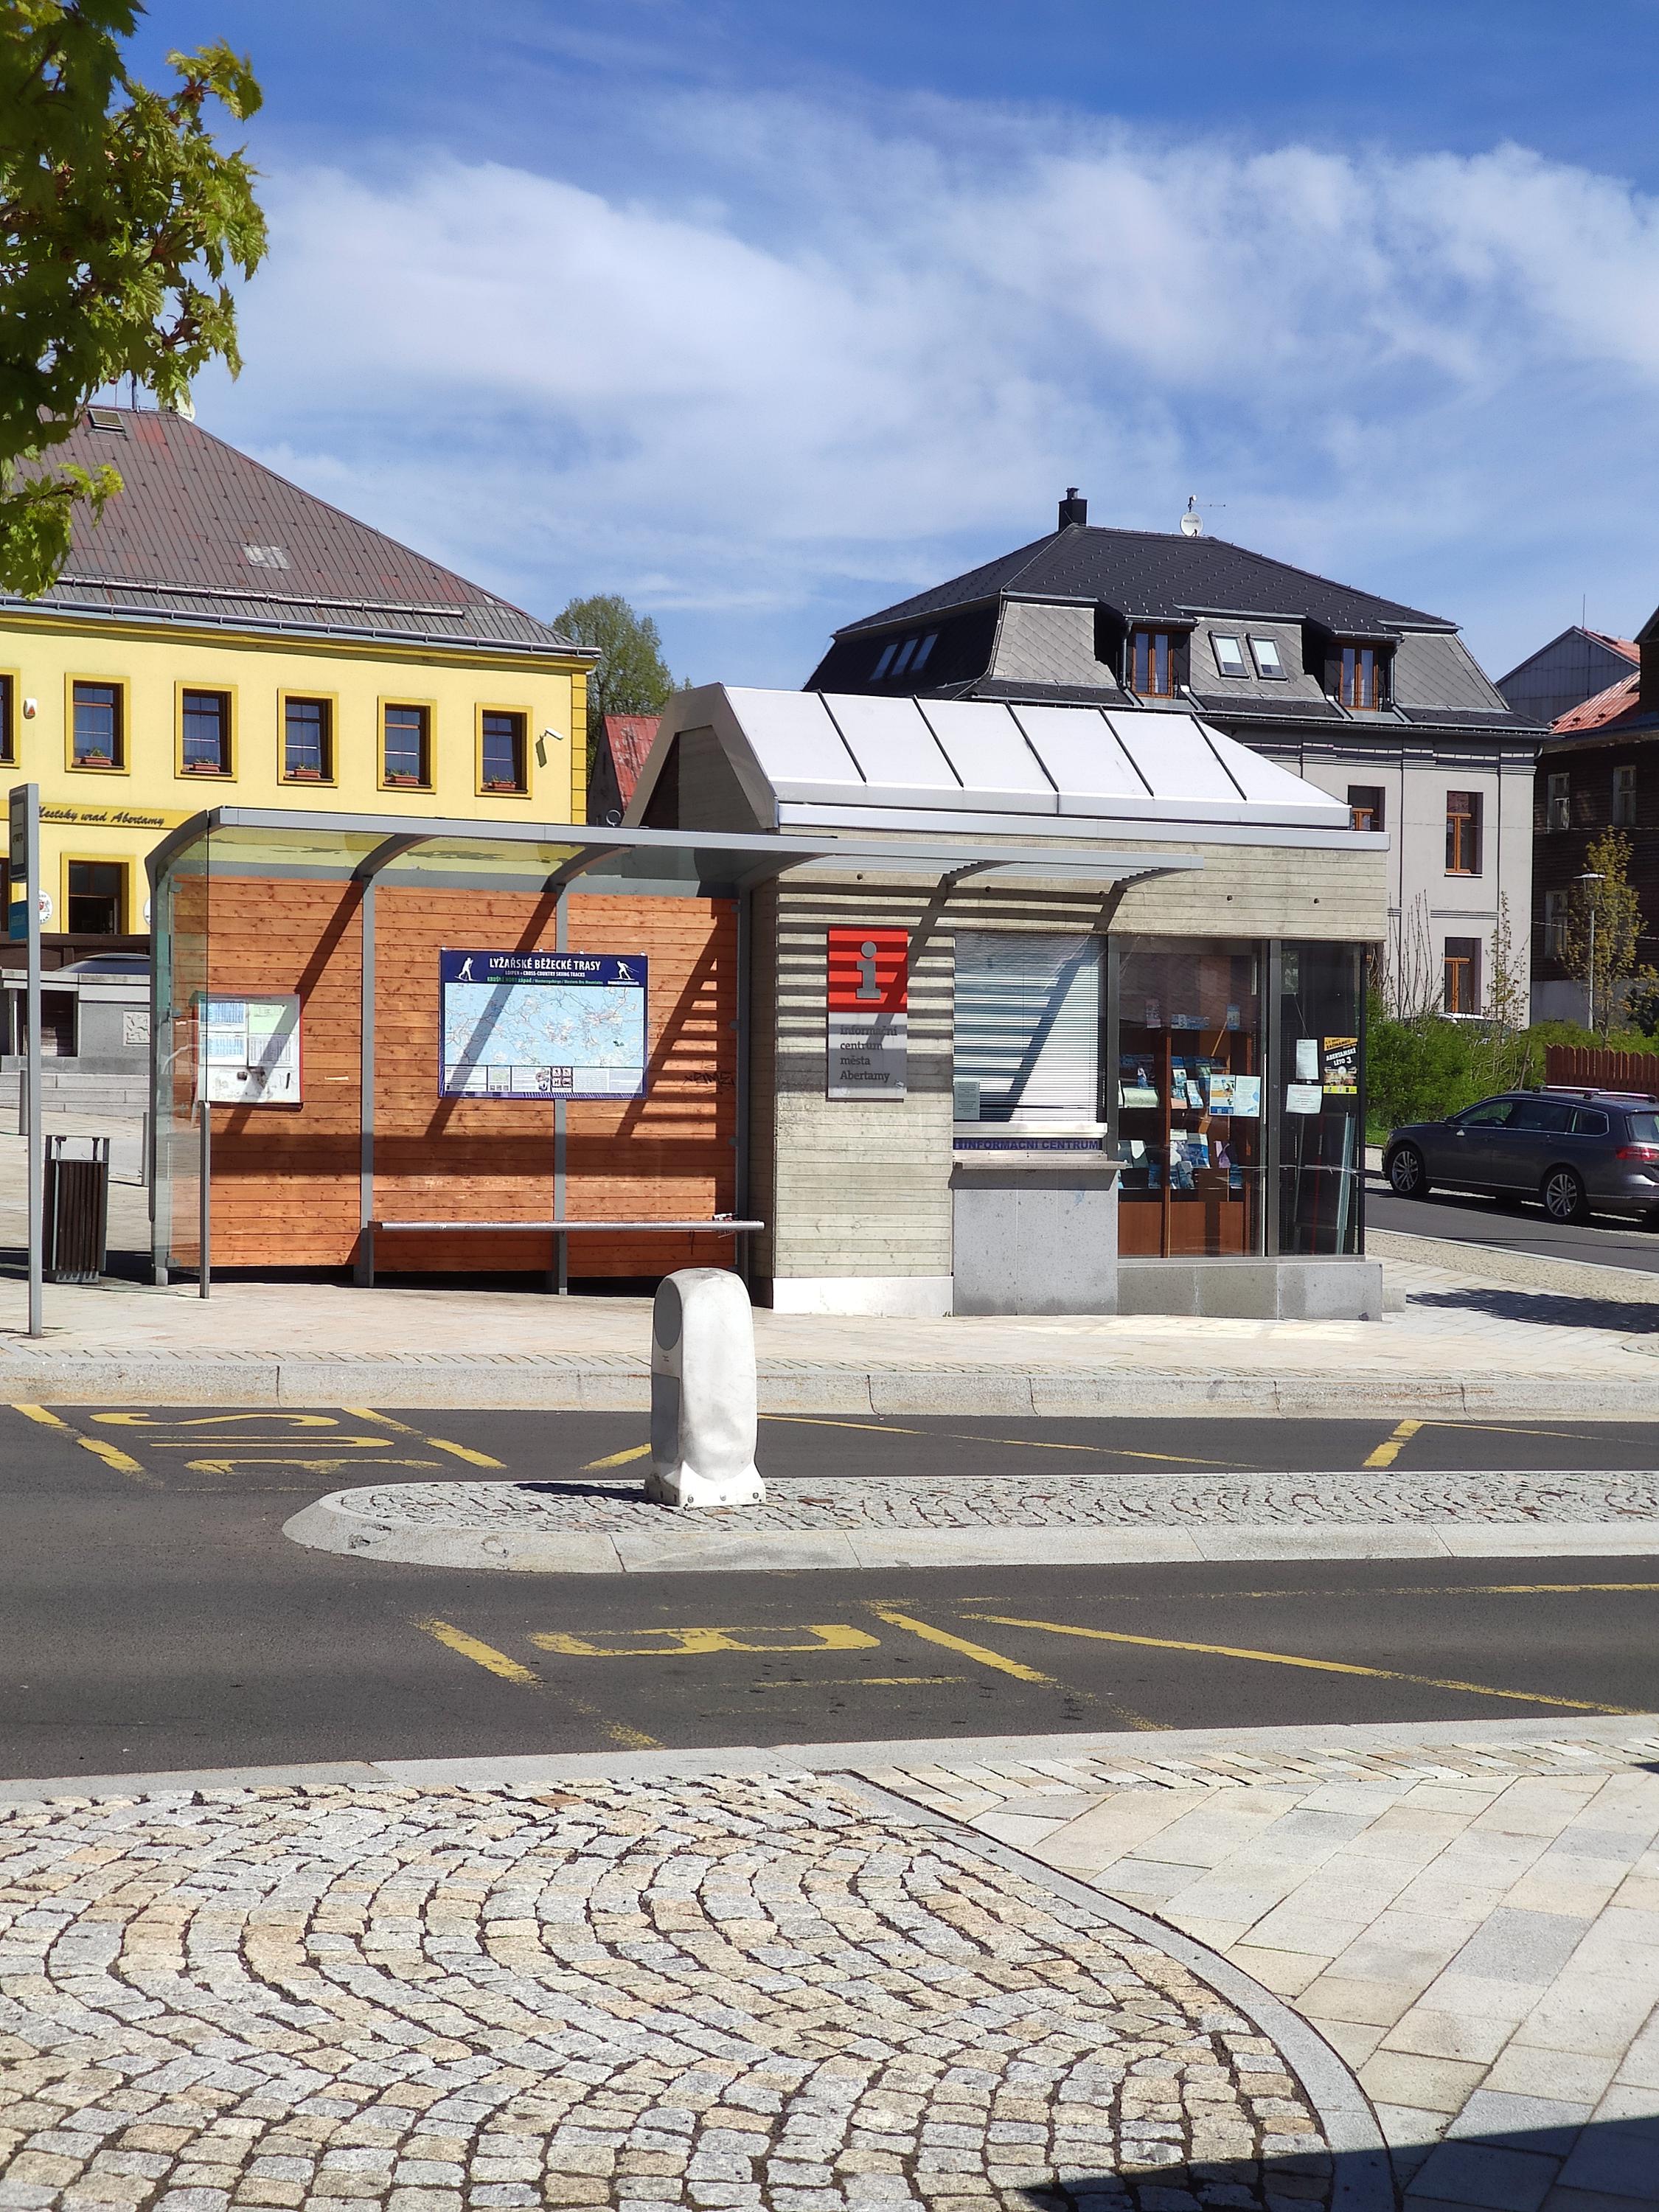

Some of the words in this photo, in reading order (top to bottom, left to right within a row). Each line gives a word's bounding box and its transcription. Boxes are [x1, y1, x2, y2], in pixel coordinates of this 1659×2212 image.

[111, 811, 164, 827] Abertamy
[490, 956, 532, 969] LYŽAŘSKÉ
[535, 957, 572, 970] BĚŽECKÉ
[574, 960, 601, 971] TRASY
[840, 1024, 897, 1036] informační
[840, 1040, 884, 1050] centrum
[840, 1055, 871, 1065] města
[839, 1070, 891, 1083] Abertamy
[1040, 1140, 1099, 1150] CENTRUM
